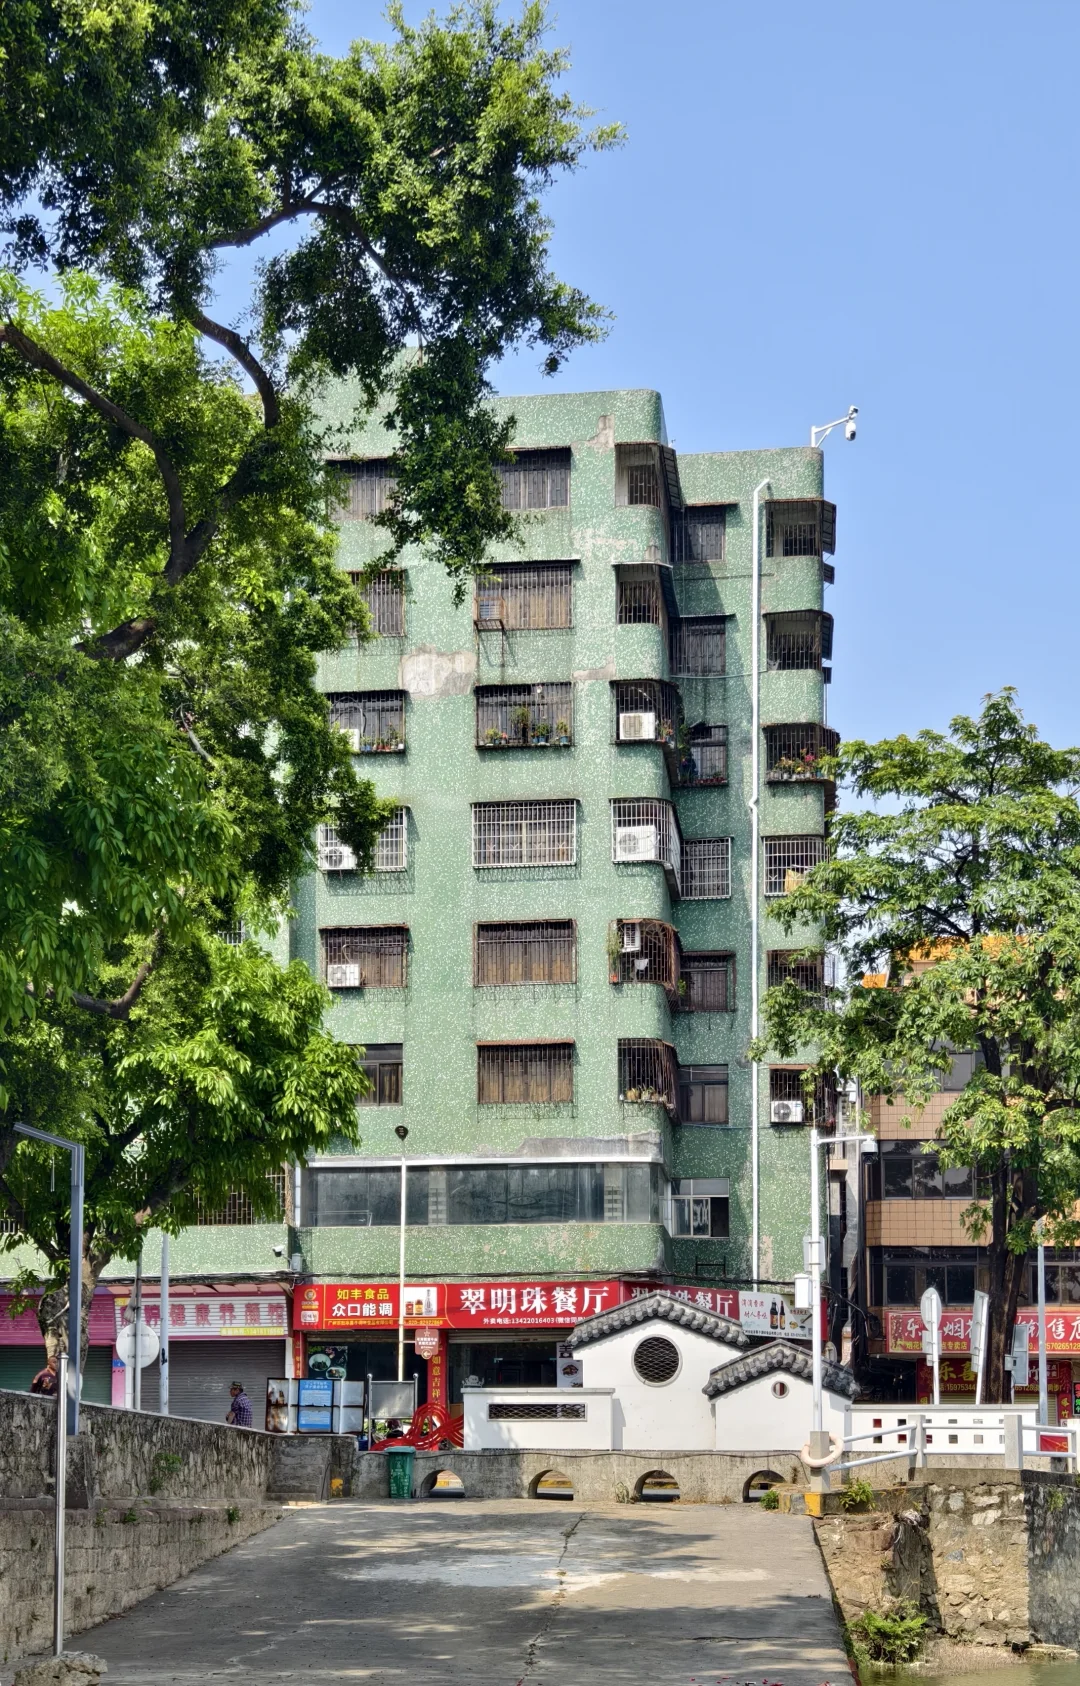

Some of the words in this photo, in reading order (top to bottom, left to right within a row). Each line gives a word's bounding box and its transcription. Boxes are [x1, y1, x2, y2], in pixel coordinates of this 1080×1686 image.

[337, 1288, 389, 1301] 如丰食品
[460, 1286, 610, 1315] 翠明珠餐厅
[332, 1303, 393, 1317] 众口能调
